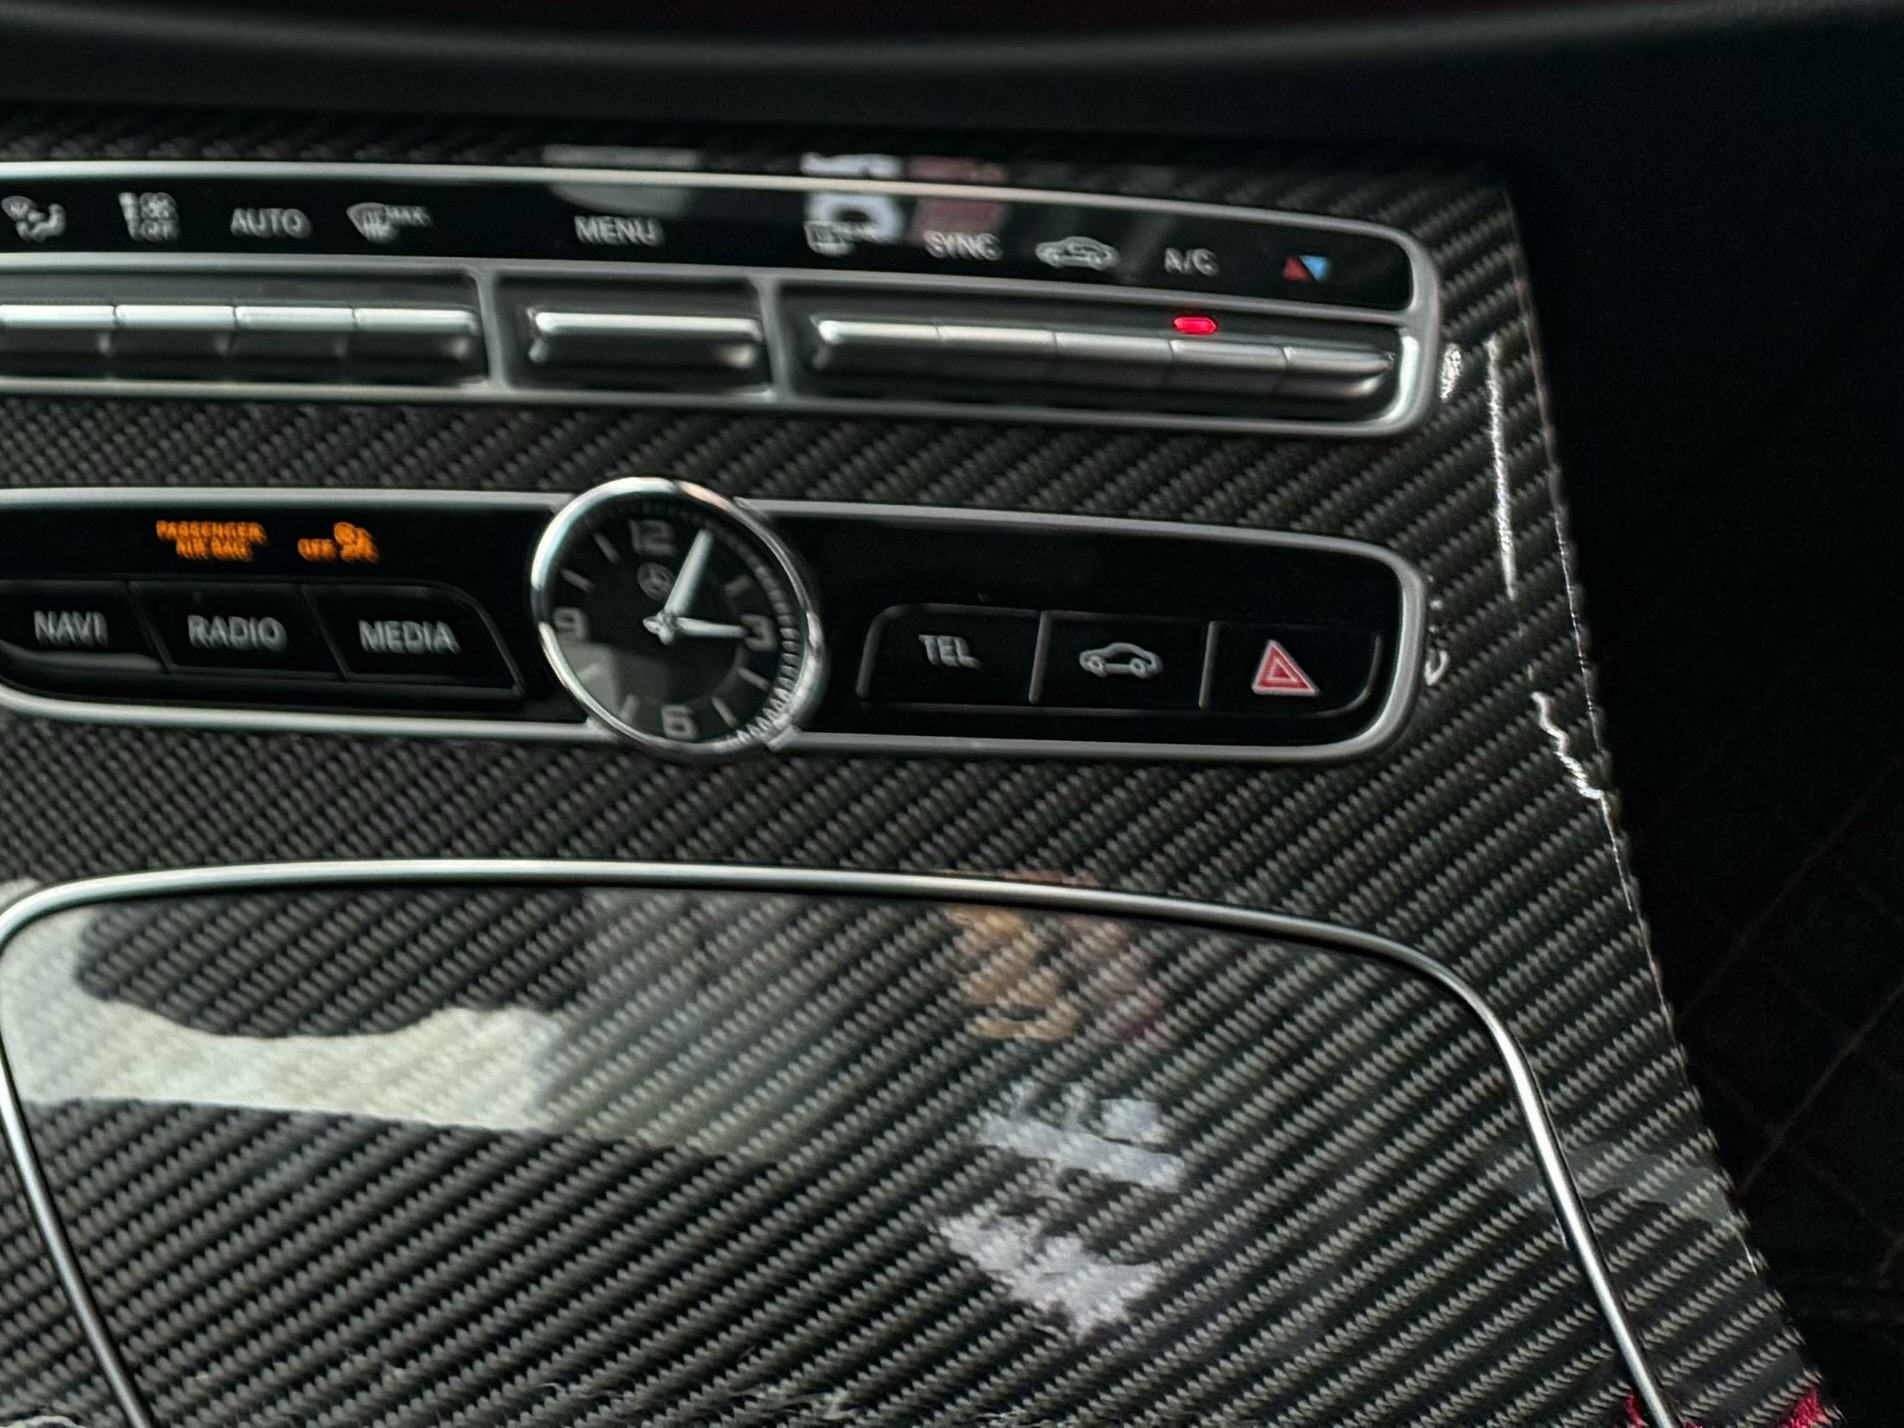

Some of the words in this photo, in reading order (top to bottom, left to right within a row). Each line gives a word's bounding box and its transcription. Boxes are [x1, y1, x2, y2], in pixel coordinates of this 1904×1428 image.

[230, 207, 312, 241] AUTO
[573, 214, 666, 247] MENU
[923, 229, 1004, 262] SYNC
[1164, 247, 1219, 277] A/C
[32, 609, 110, 645] NAVI
[187, 614, 289, 652] RADIO
[357, 619, 462, 656] MEDIA
[741, 613, 778, 652] 3
[917, 632, 982, 671] TEL
[660, 703, 699, 740] 6
